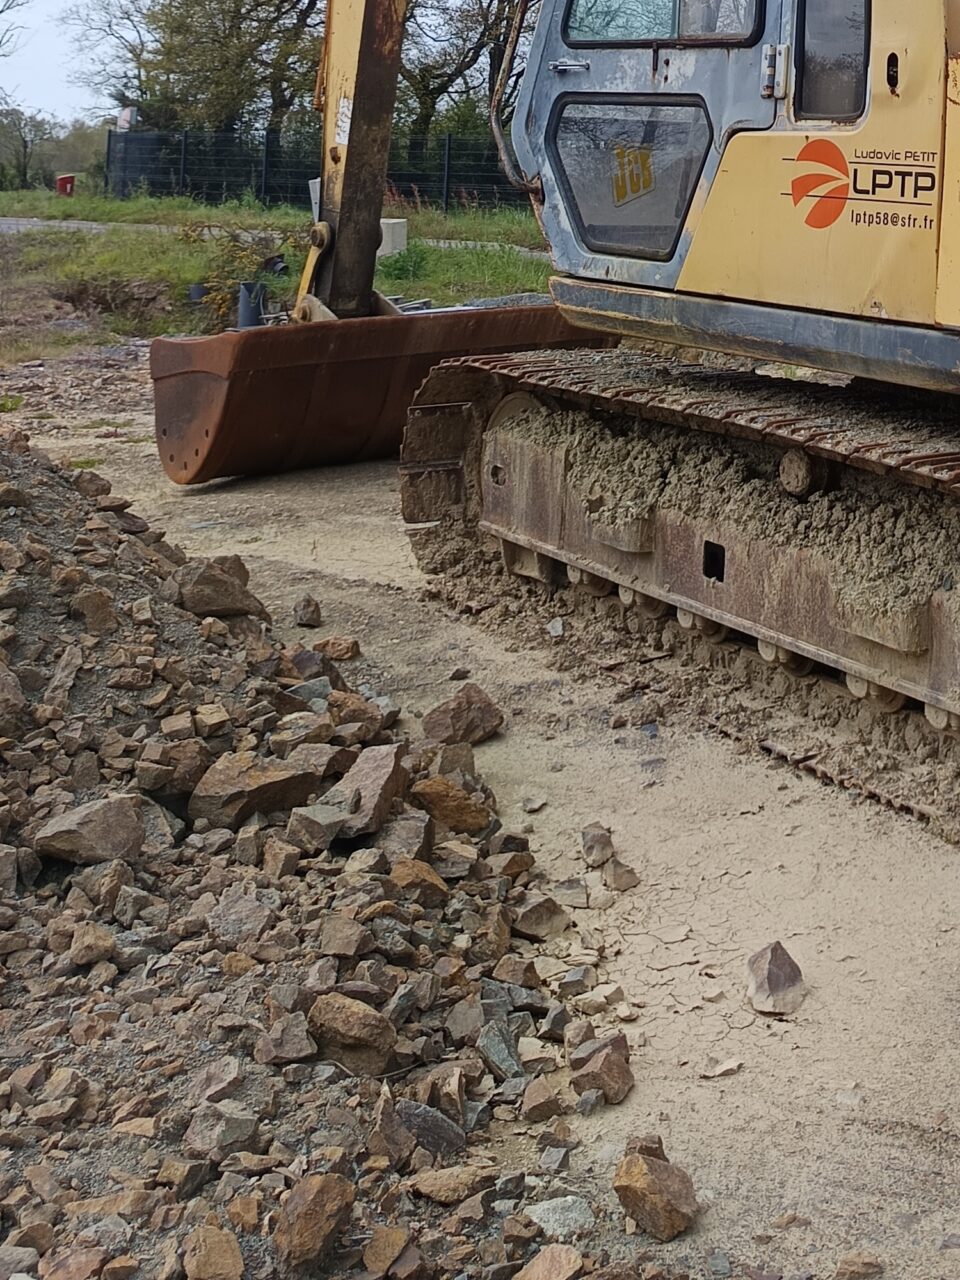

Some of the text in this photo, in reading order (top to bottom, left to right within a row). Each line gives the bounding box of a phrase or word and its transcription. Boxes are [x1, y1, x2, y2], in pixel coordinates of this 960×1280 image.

[854, 148, 938, 163] Ludovic PETIT
[852, 168, 936, 199] LPTP
[851, 209, 934, 230] lptp58@sfr.fr
